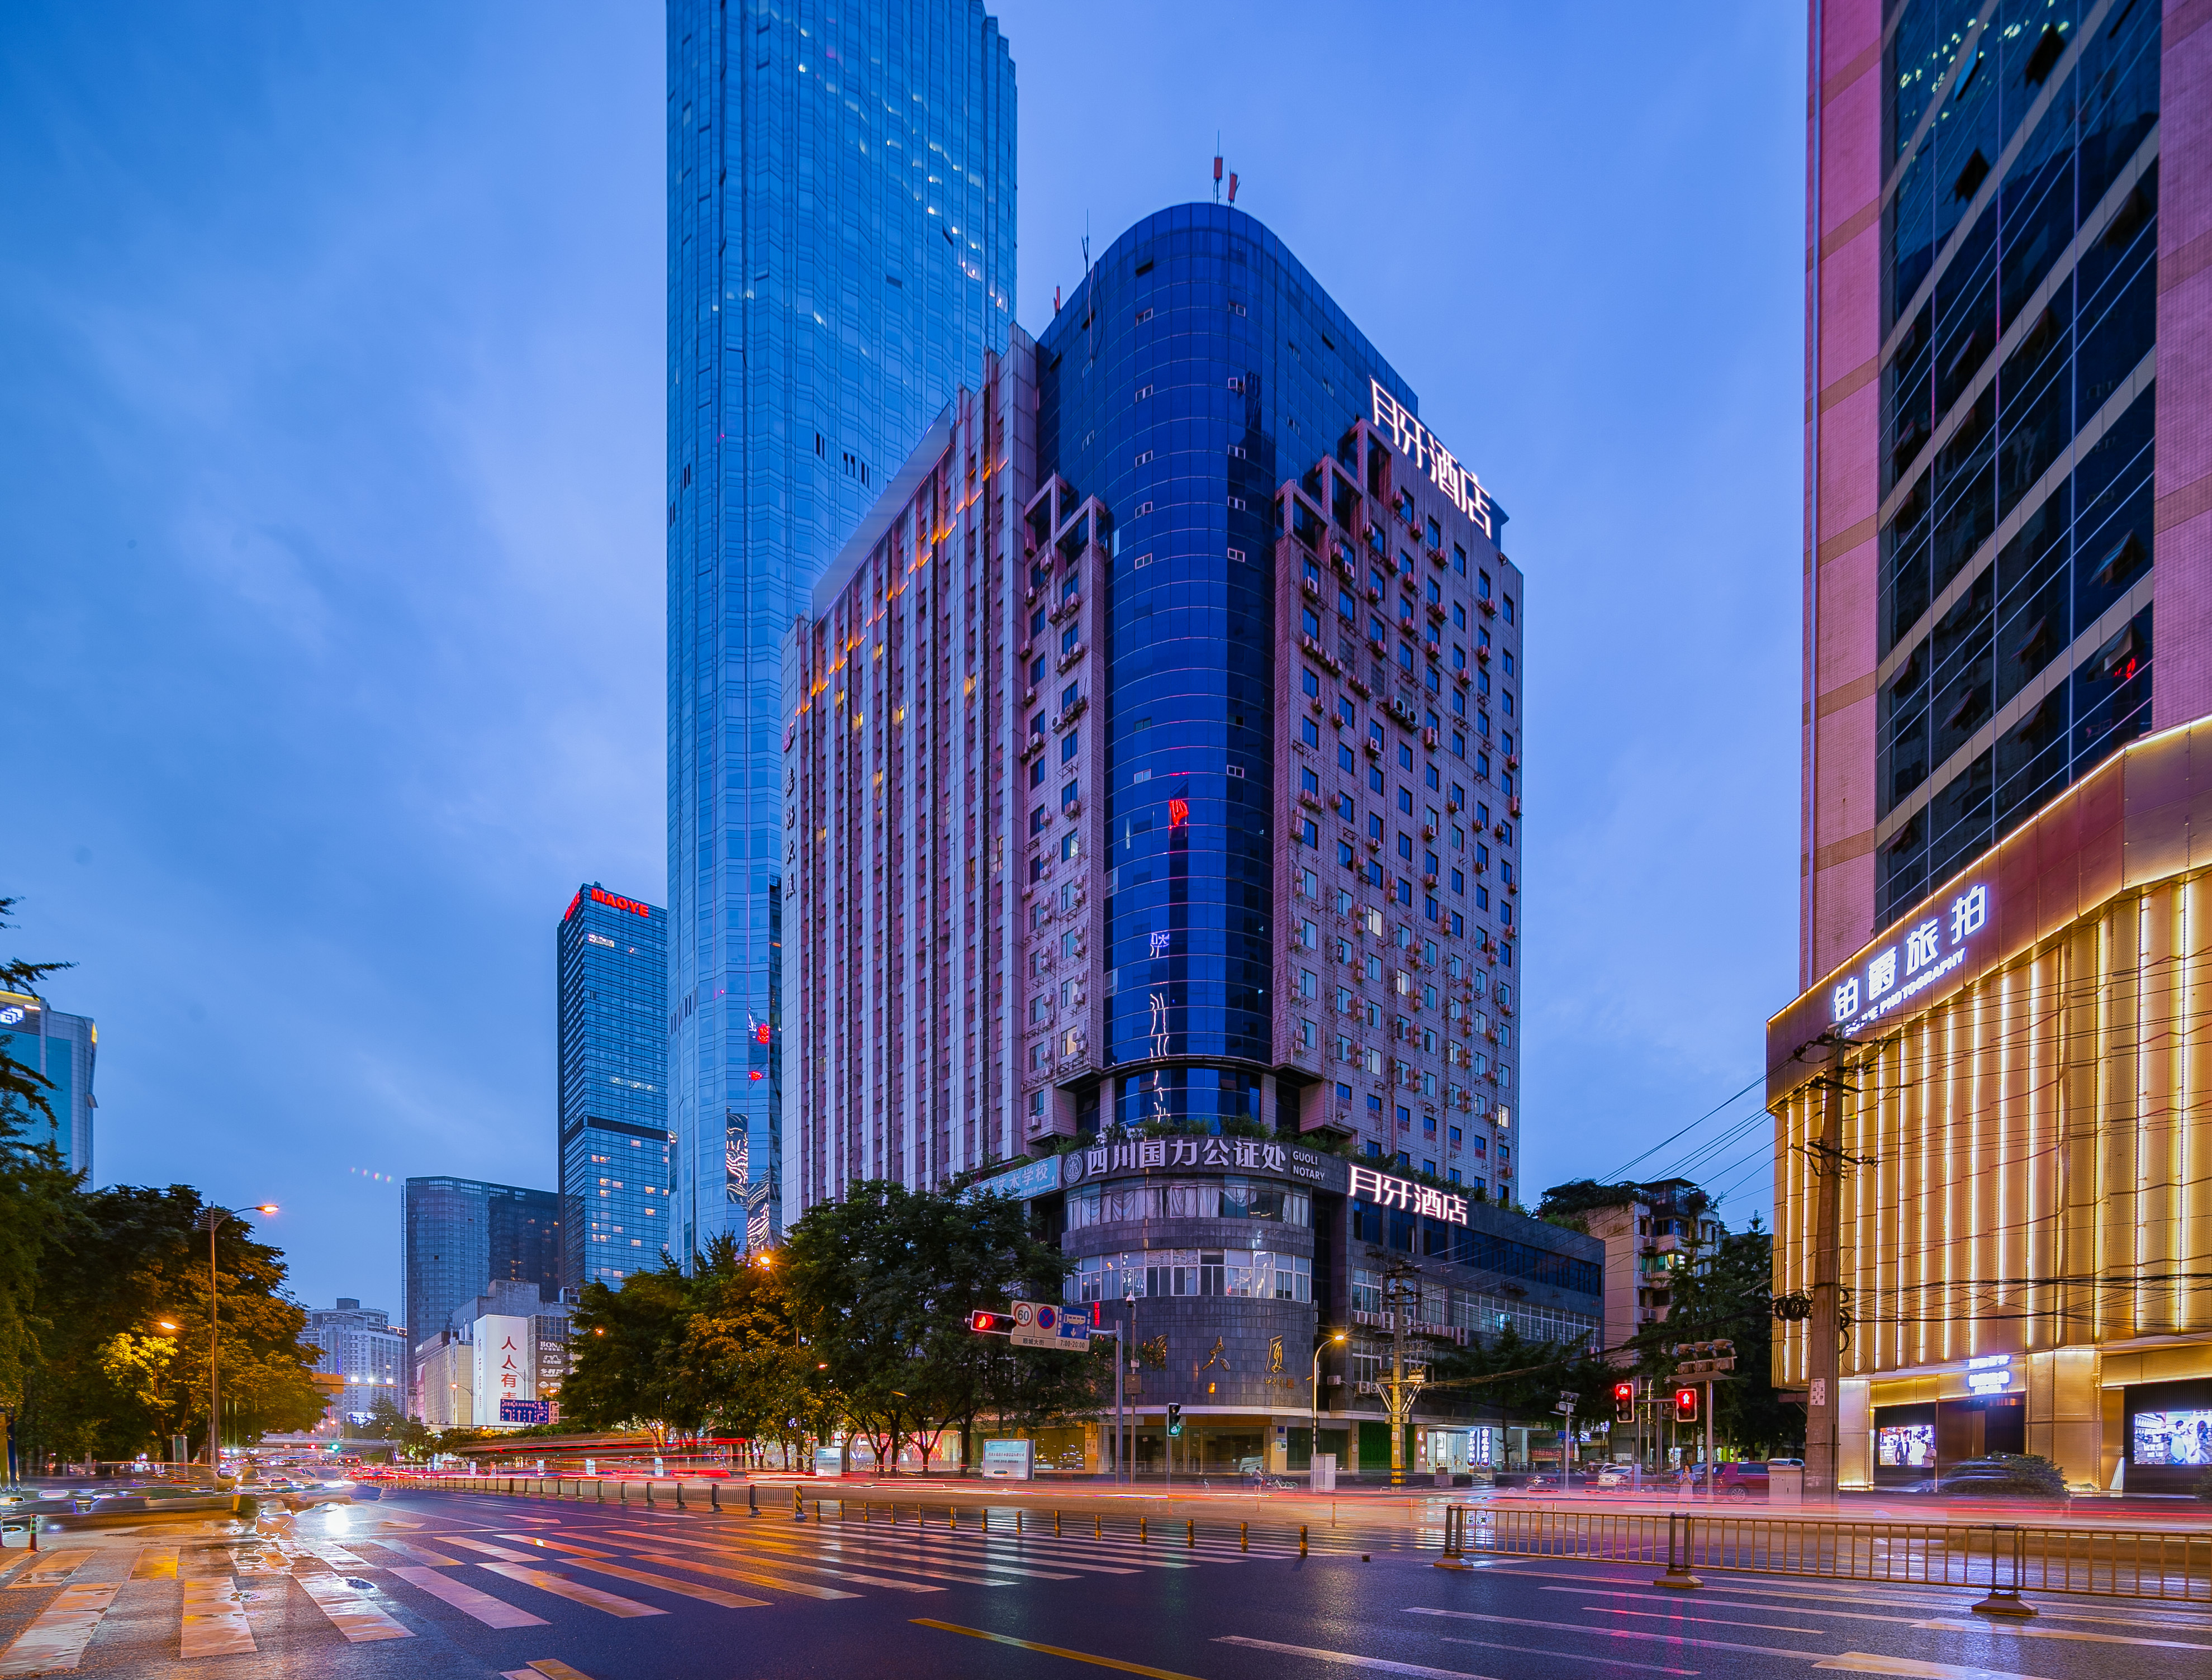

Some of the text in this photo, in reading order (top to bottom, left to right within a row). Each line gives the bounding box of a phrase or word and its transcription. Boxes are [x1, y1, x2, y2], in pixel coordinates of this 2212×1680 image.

[1370, 376, 1492, 539] 月牙酒店
[591, 888, 649, 918] MAOYE
[1833, 885, 1986, 1022] 铂爵旅拍
[1879, 947, 1967, 1014] PHOTOGRAPHY
[1088, 1139, 1286, 1176] 四川国力公证处
[1293, 1150, 1318, 1166] GUOLI
[1293, 1165, 1325, 1181] NOTARY
[1347, 1164, 1468, 1226] 月牙酒店
[1017, 1309, 1029, 1321] 60
[1022, 1337, 1045, 1346] 顺城大街
[1060, 1340, 1085, 1349] 7:00-20:00
